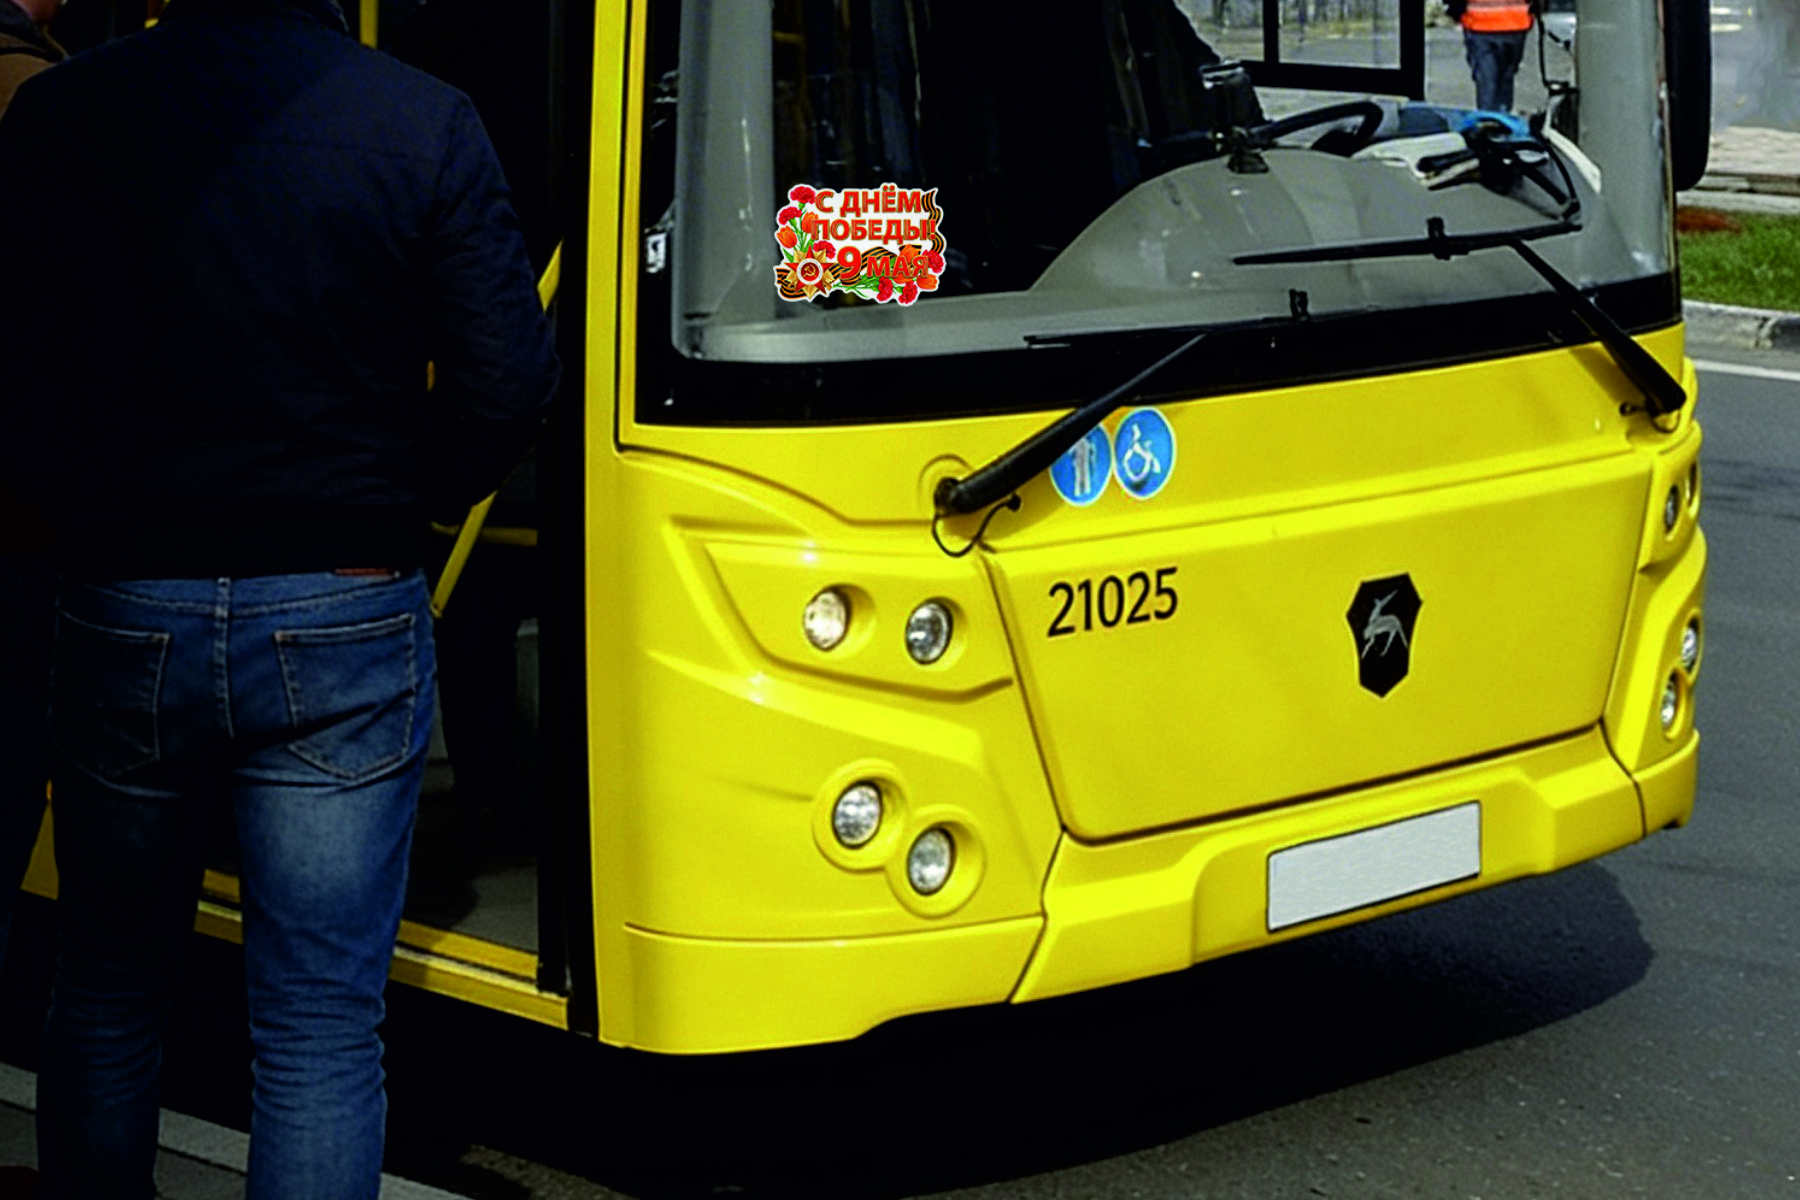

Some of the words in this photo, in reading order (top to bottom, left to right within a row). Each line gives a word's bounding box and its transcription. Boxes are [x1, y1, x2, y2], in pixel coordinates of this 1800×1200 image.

[815, 191, 834, 213] С
[840, 185, 922, 217] ДНЁМ
[811, 219, 937, 245] ПОБЕДЫ!
[837, 246, 862, 280] 9
[866, 255, 929, 279] МАЯ
[1047, 566, 1179, 638] 21025
